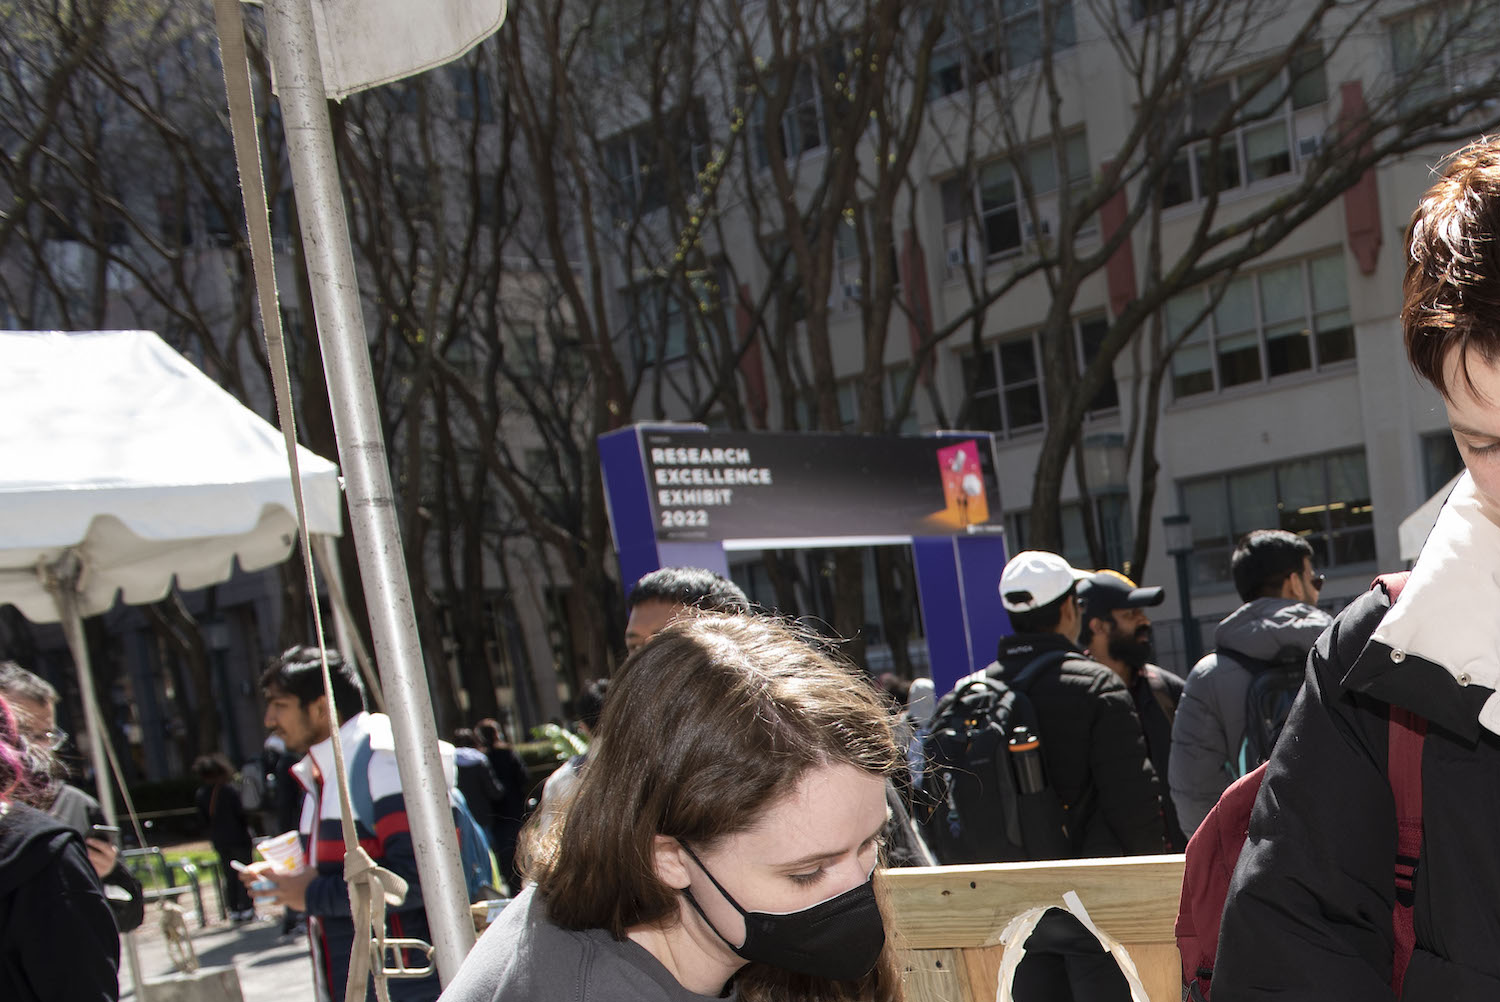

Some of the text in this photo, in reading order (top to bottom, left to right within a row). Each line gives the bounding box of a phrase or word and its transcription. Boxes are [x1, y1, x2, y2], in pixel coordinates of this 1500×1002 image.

[652, 448, 750, 464] RESEARCH
[655, 468, 772, 485] EXCELLENCE
[658, 489, 732, 506] EXHIBIT
[662, 510, 708, 527] 2022
